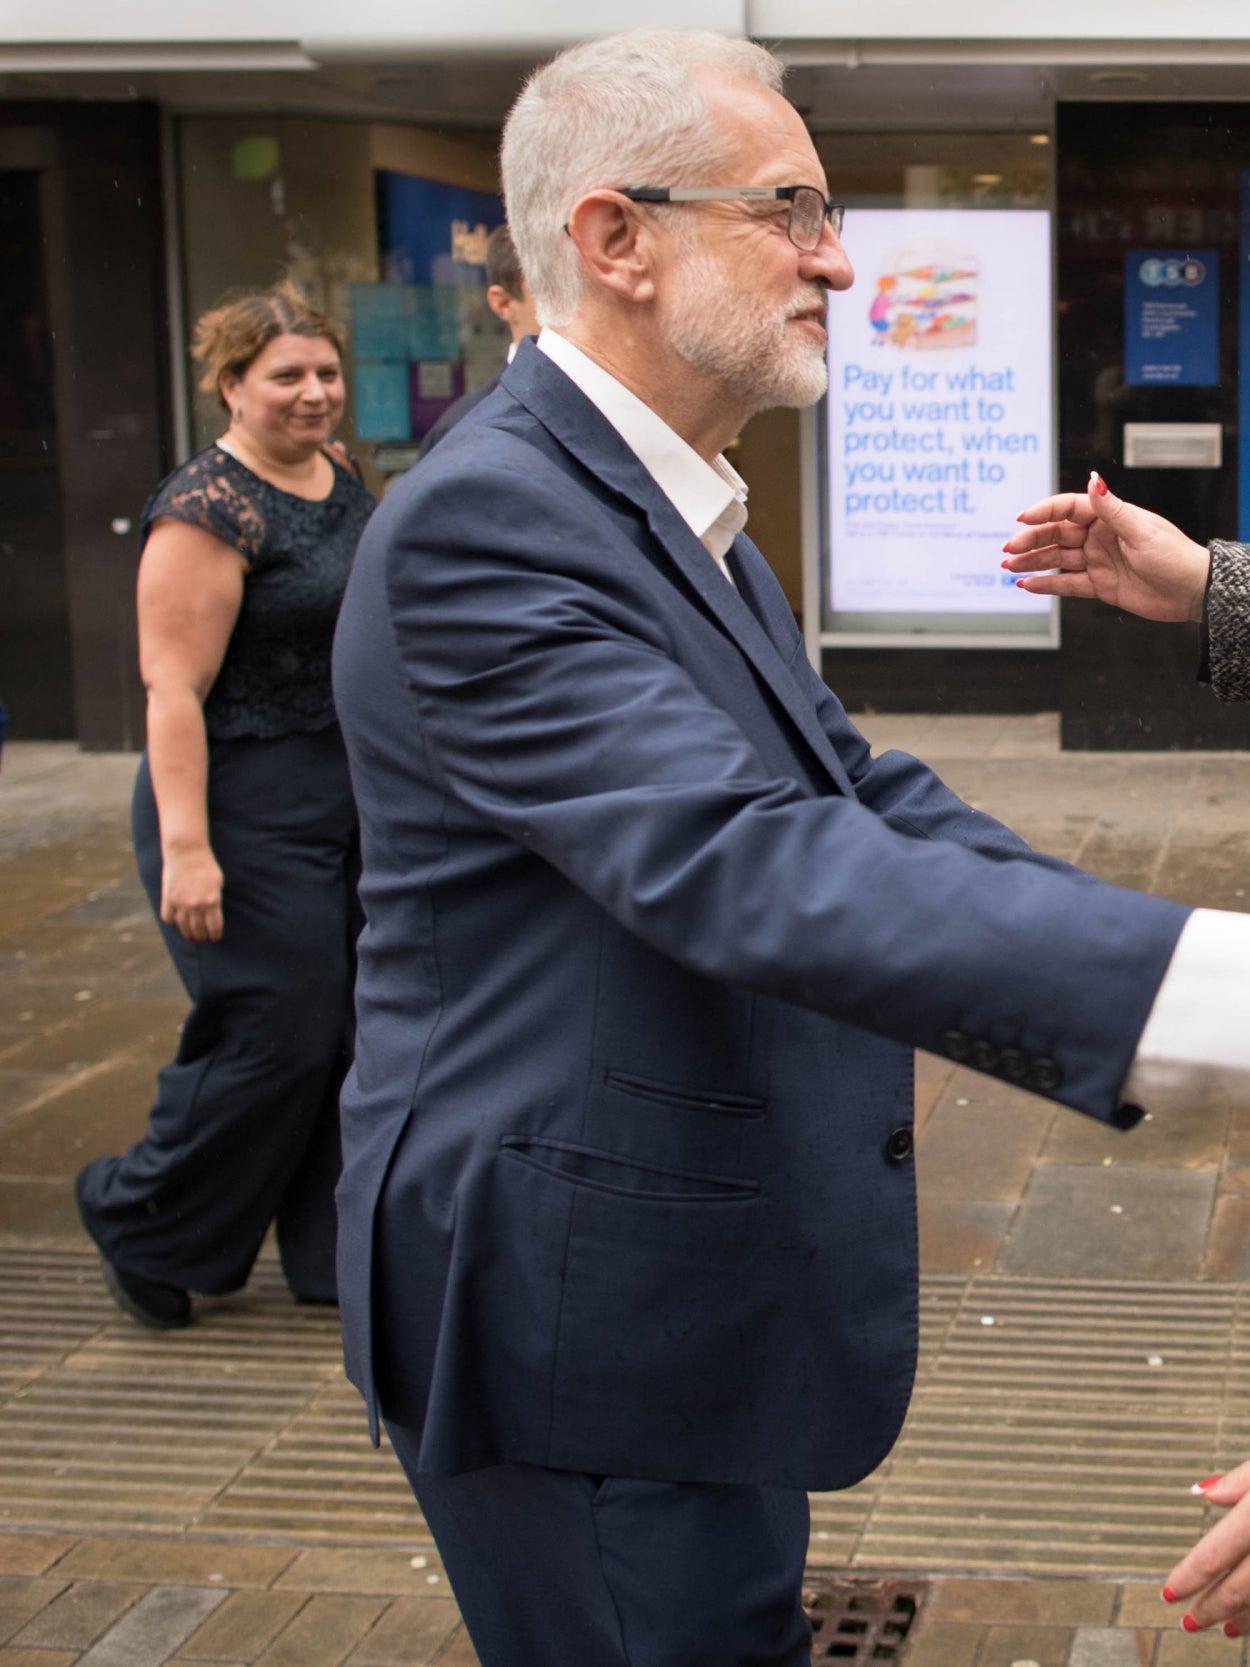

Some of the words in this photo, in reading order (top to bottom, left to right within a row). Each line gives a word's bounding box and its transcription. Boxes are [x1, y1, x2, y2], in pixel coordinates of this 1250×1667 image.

[844, 364, 893, 396] Pay
[901, 364, 938, 391] for
[946, 365, 1015, 391] what
[844, 401, 894, 426] you
[902, 397, 970, 422] want
[977, 397, 1005, 422] to
[844, 427, 953, 456] protect,
[962, 427, 1039, 452] when
[844, 462, 894, 487] you
[902, 458, 970, 482] want
[977, 458, 1005, 483] to
[844, 488, 945, 518] protect
[953, 488, 976, 514] it.
